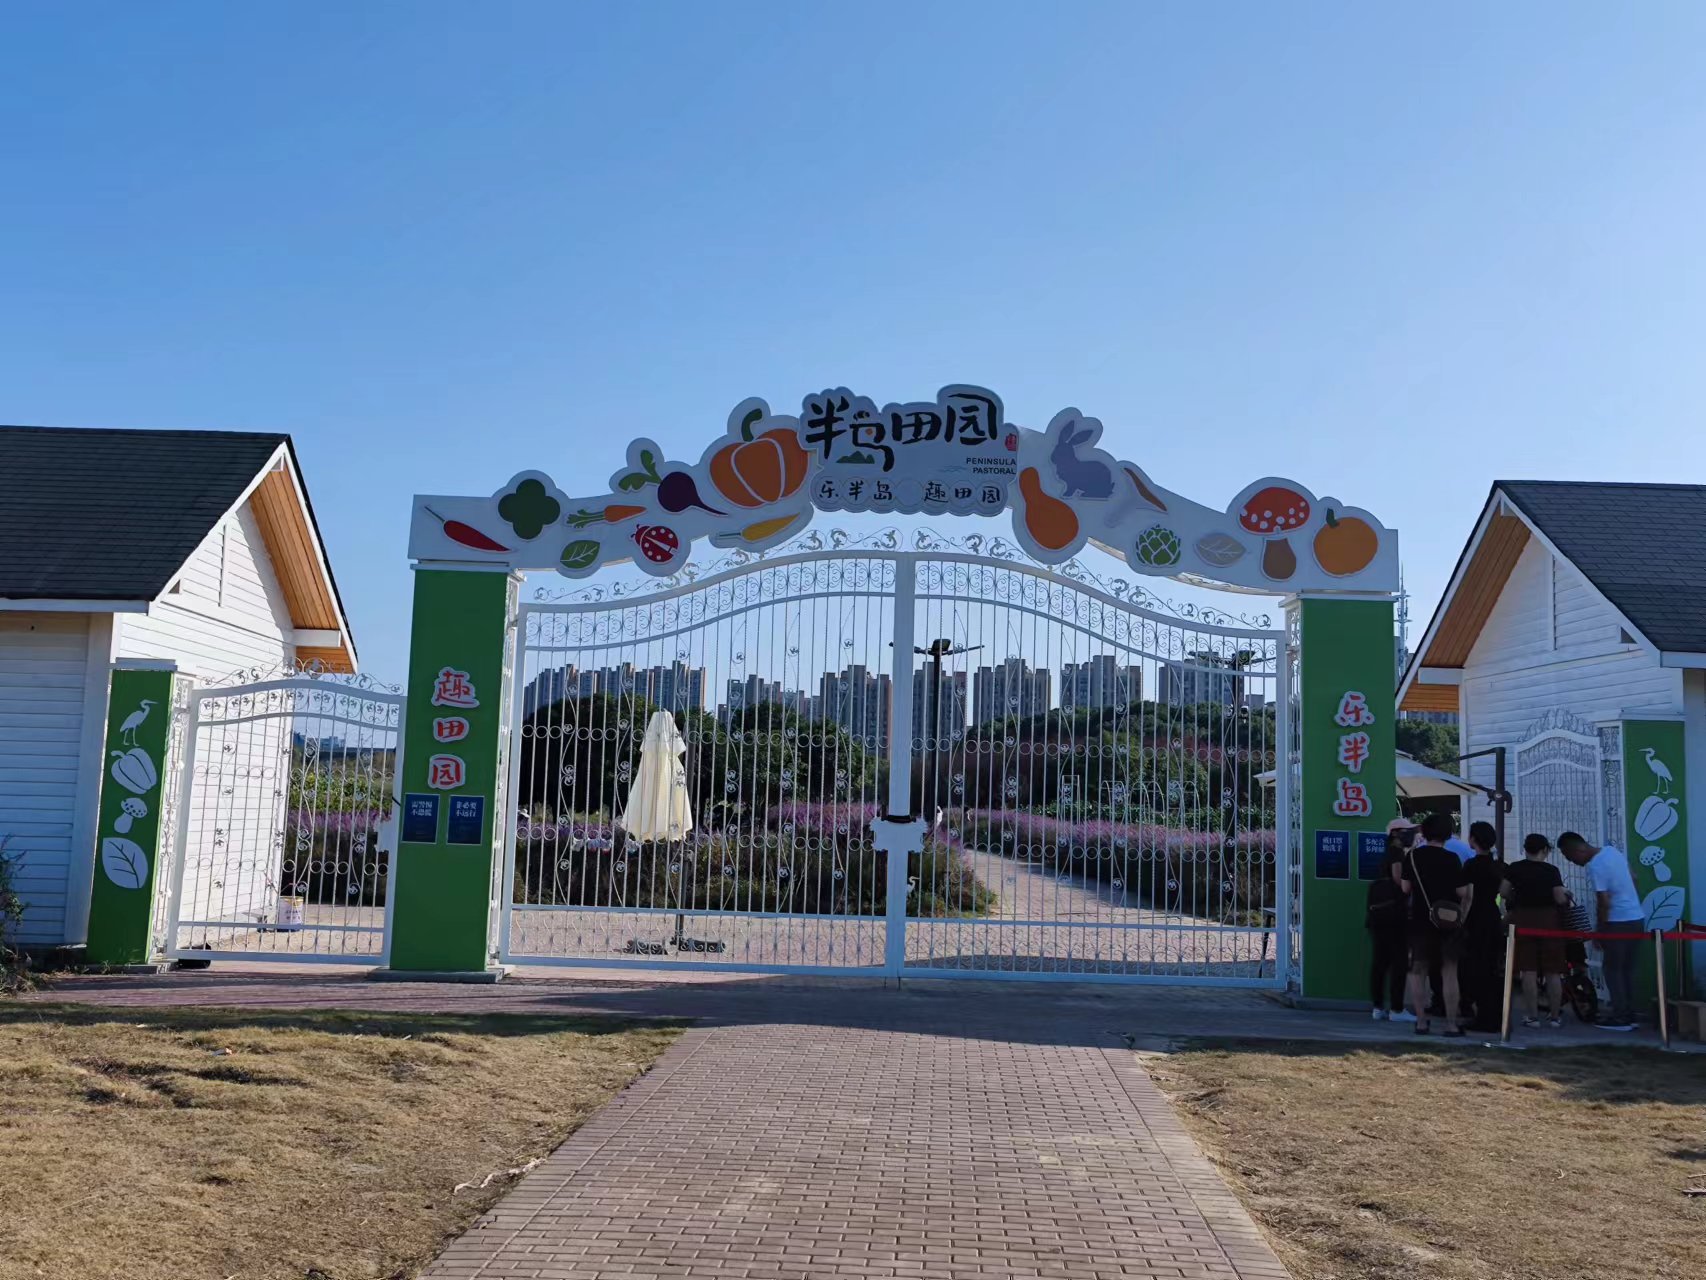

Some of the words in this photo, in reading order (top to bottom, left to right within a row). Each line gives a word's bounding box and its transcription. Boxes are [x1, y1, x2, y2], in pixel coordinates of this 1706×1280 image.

[966, 457, 1017, 466] PENINSULA
[972, 467, 1016, 475] PASTORAL
[819, 480, 893, 501] 乐半岛
[924, 481, 1001, 504] 趣田园
[432, 671, 476, 786] 趣田园
[1338, 694, 1372, 813] 乐半岛
